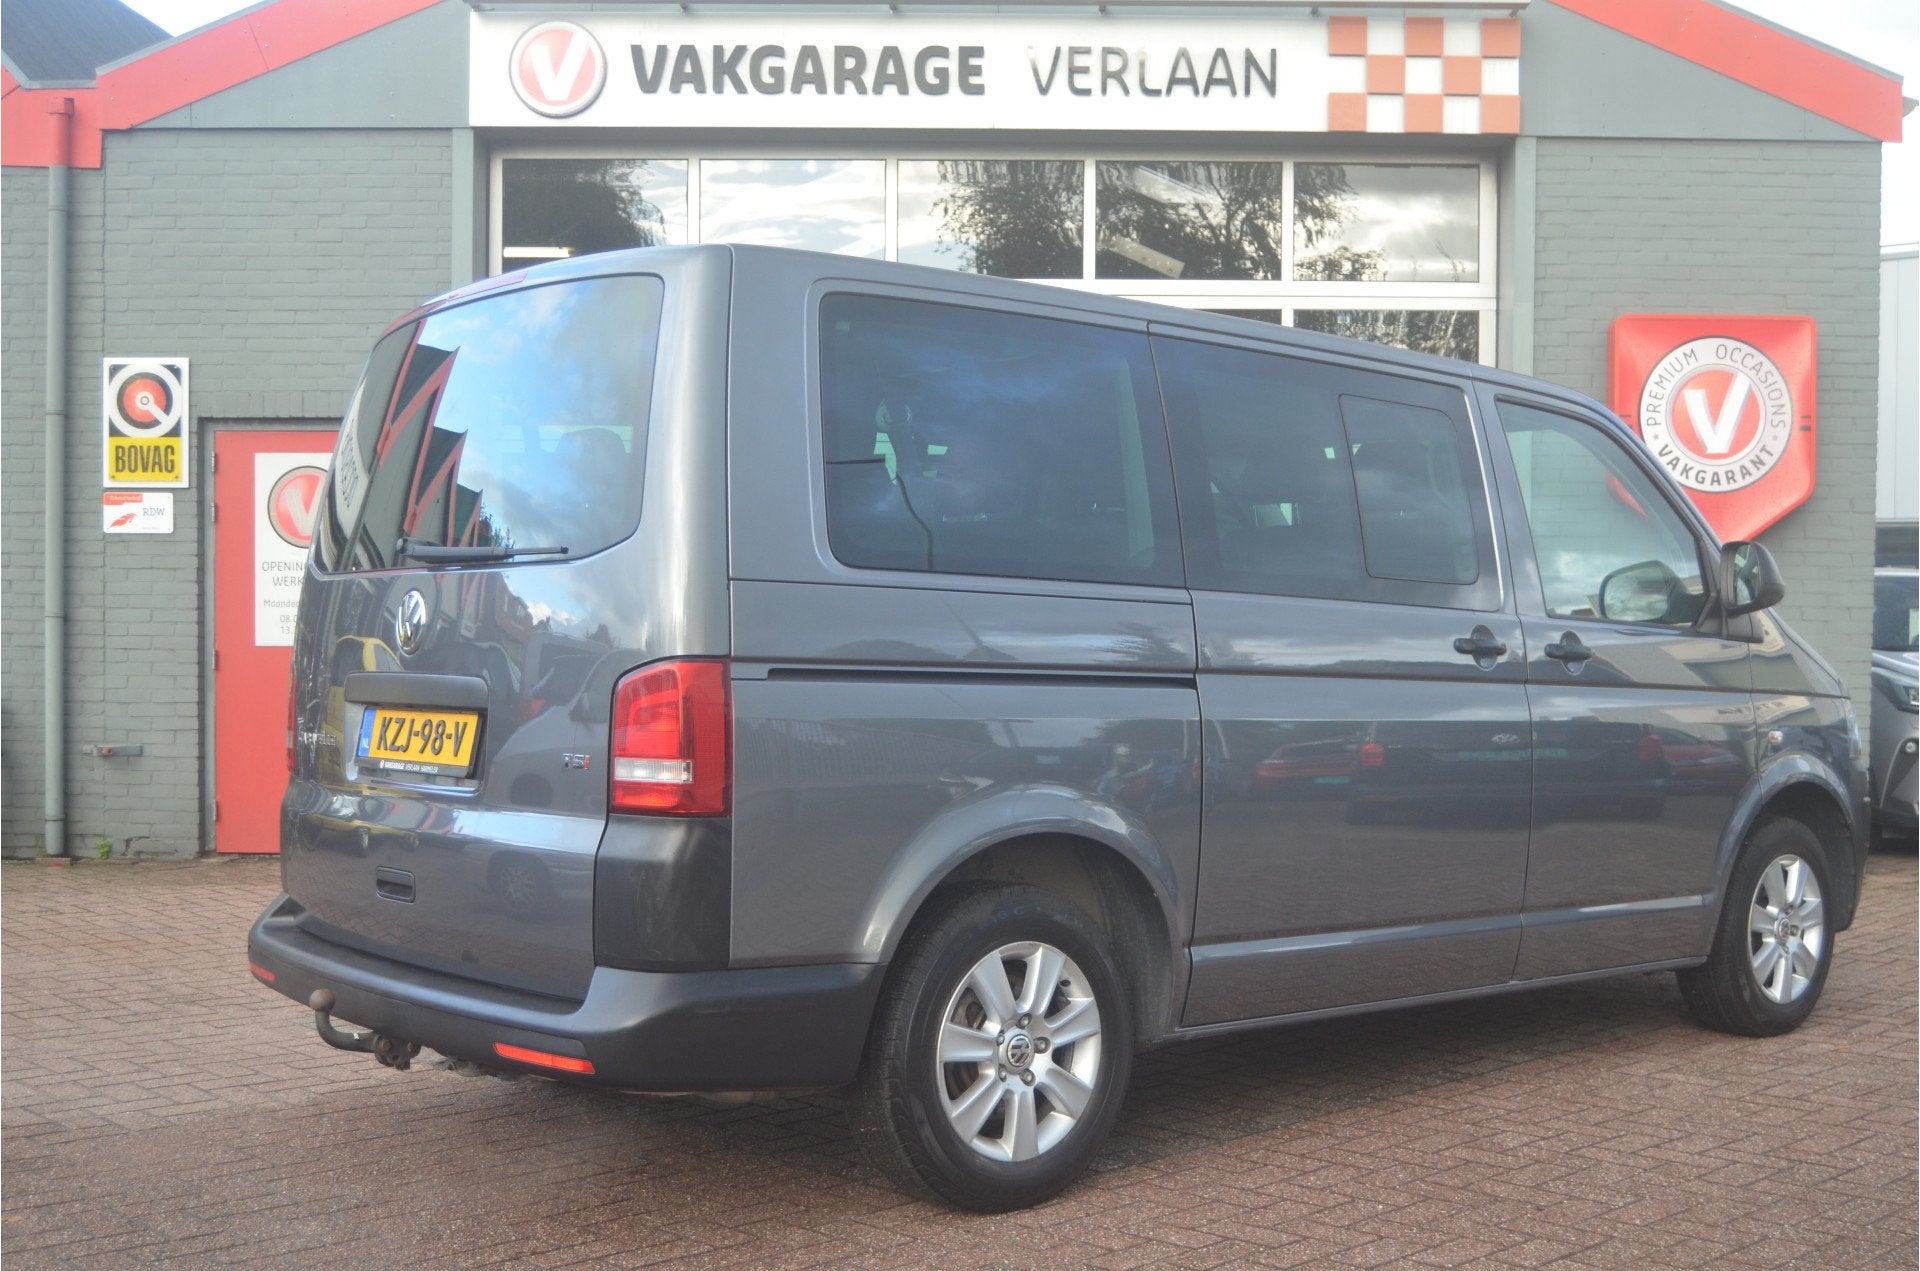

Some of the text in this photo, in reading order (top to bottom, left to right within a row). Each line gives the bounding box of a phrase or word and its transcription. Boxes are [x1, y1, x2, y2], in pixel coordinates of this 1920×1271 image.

[630, 43, 1278, 97] VAKGARAGE VERLAAN
[1646, 344, 1786, 429] PREMIUM OCCASIONS
[115, 444, 176, 474] BOVAG
[1658, 443, 1774, 486] VAKGARANT
[143, 507, 165, 517] RDW
[262, 561, 305, 572] OPENIN
[376, 716, 468, 757] KZJ-98-V
